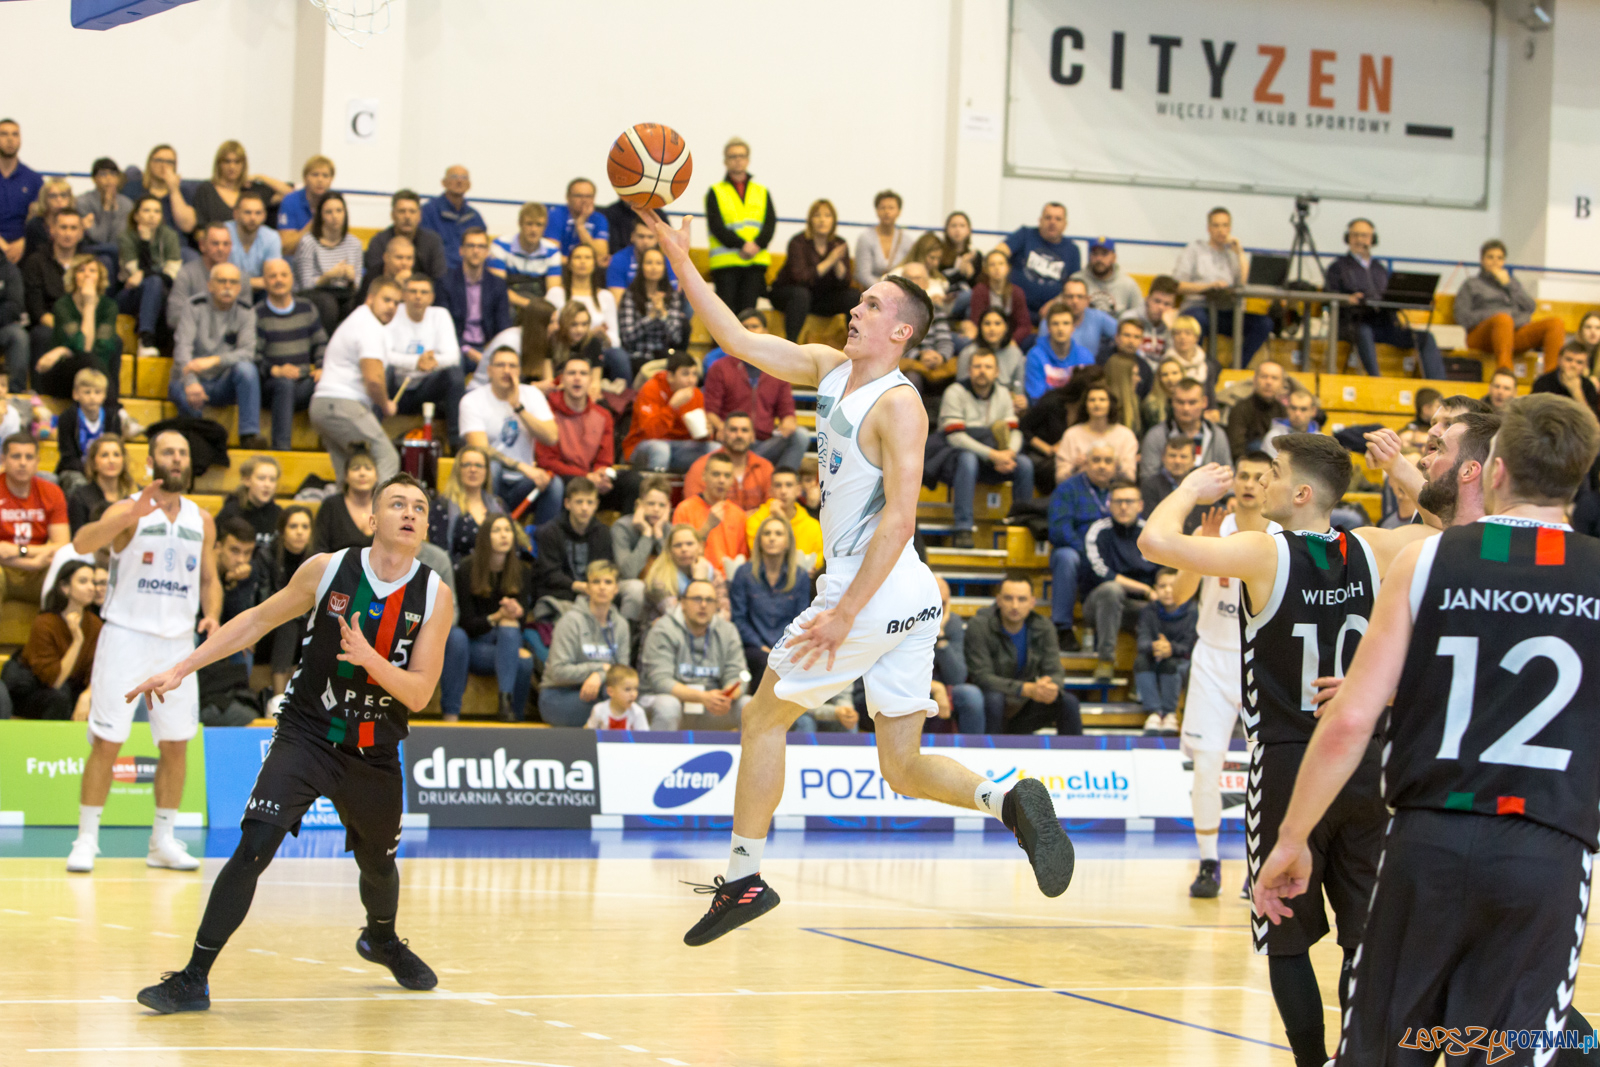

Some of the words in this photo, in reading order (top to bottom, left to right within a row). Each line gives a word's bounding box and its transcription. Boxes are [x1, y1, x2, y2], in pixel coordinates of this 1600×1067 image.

[1050, 25, 1393, 114] CITYZEN
[351, 110, 374, 139] C
[1156, 101, 1214, 120] WIĘCEJ
[1256, 109, 1297, 126] KLUB
[1305, 112, 1391, 134] SPORTOWY
[1576, 196, 1590, 218] B
[1438, 588, 1600, 620] JANKOWSKI
[391, 639, 413, 668] 5
[344, 689, 392, 707] PEC
[1435, 635, 1583, 771] 12
[26, 757, 84, 778] Frytki
[413, 746, 595, 791] drukma
[663, 769, 720, 789] atrem
[259, 799, 280, 811] PEC
[418, 791, 501, 806] DRUKARNIA
[505, 790, 596, 807] SKOCZYŃSKI
